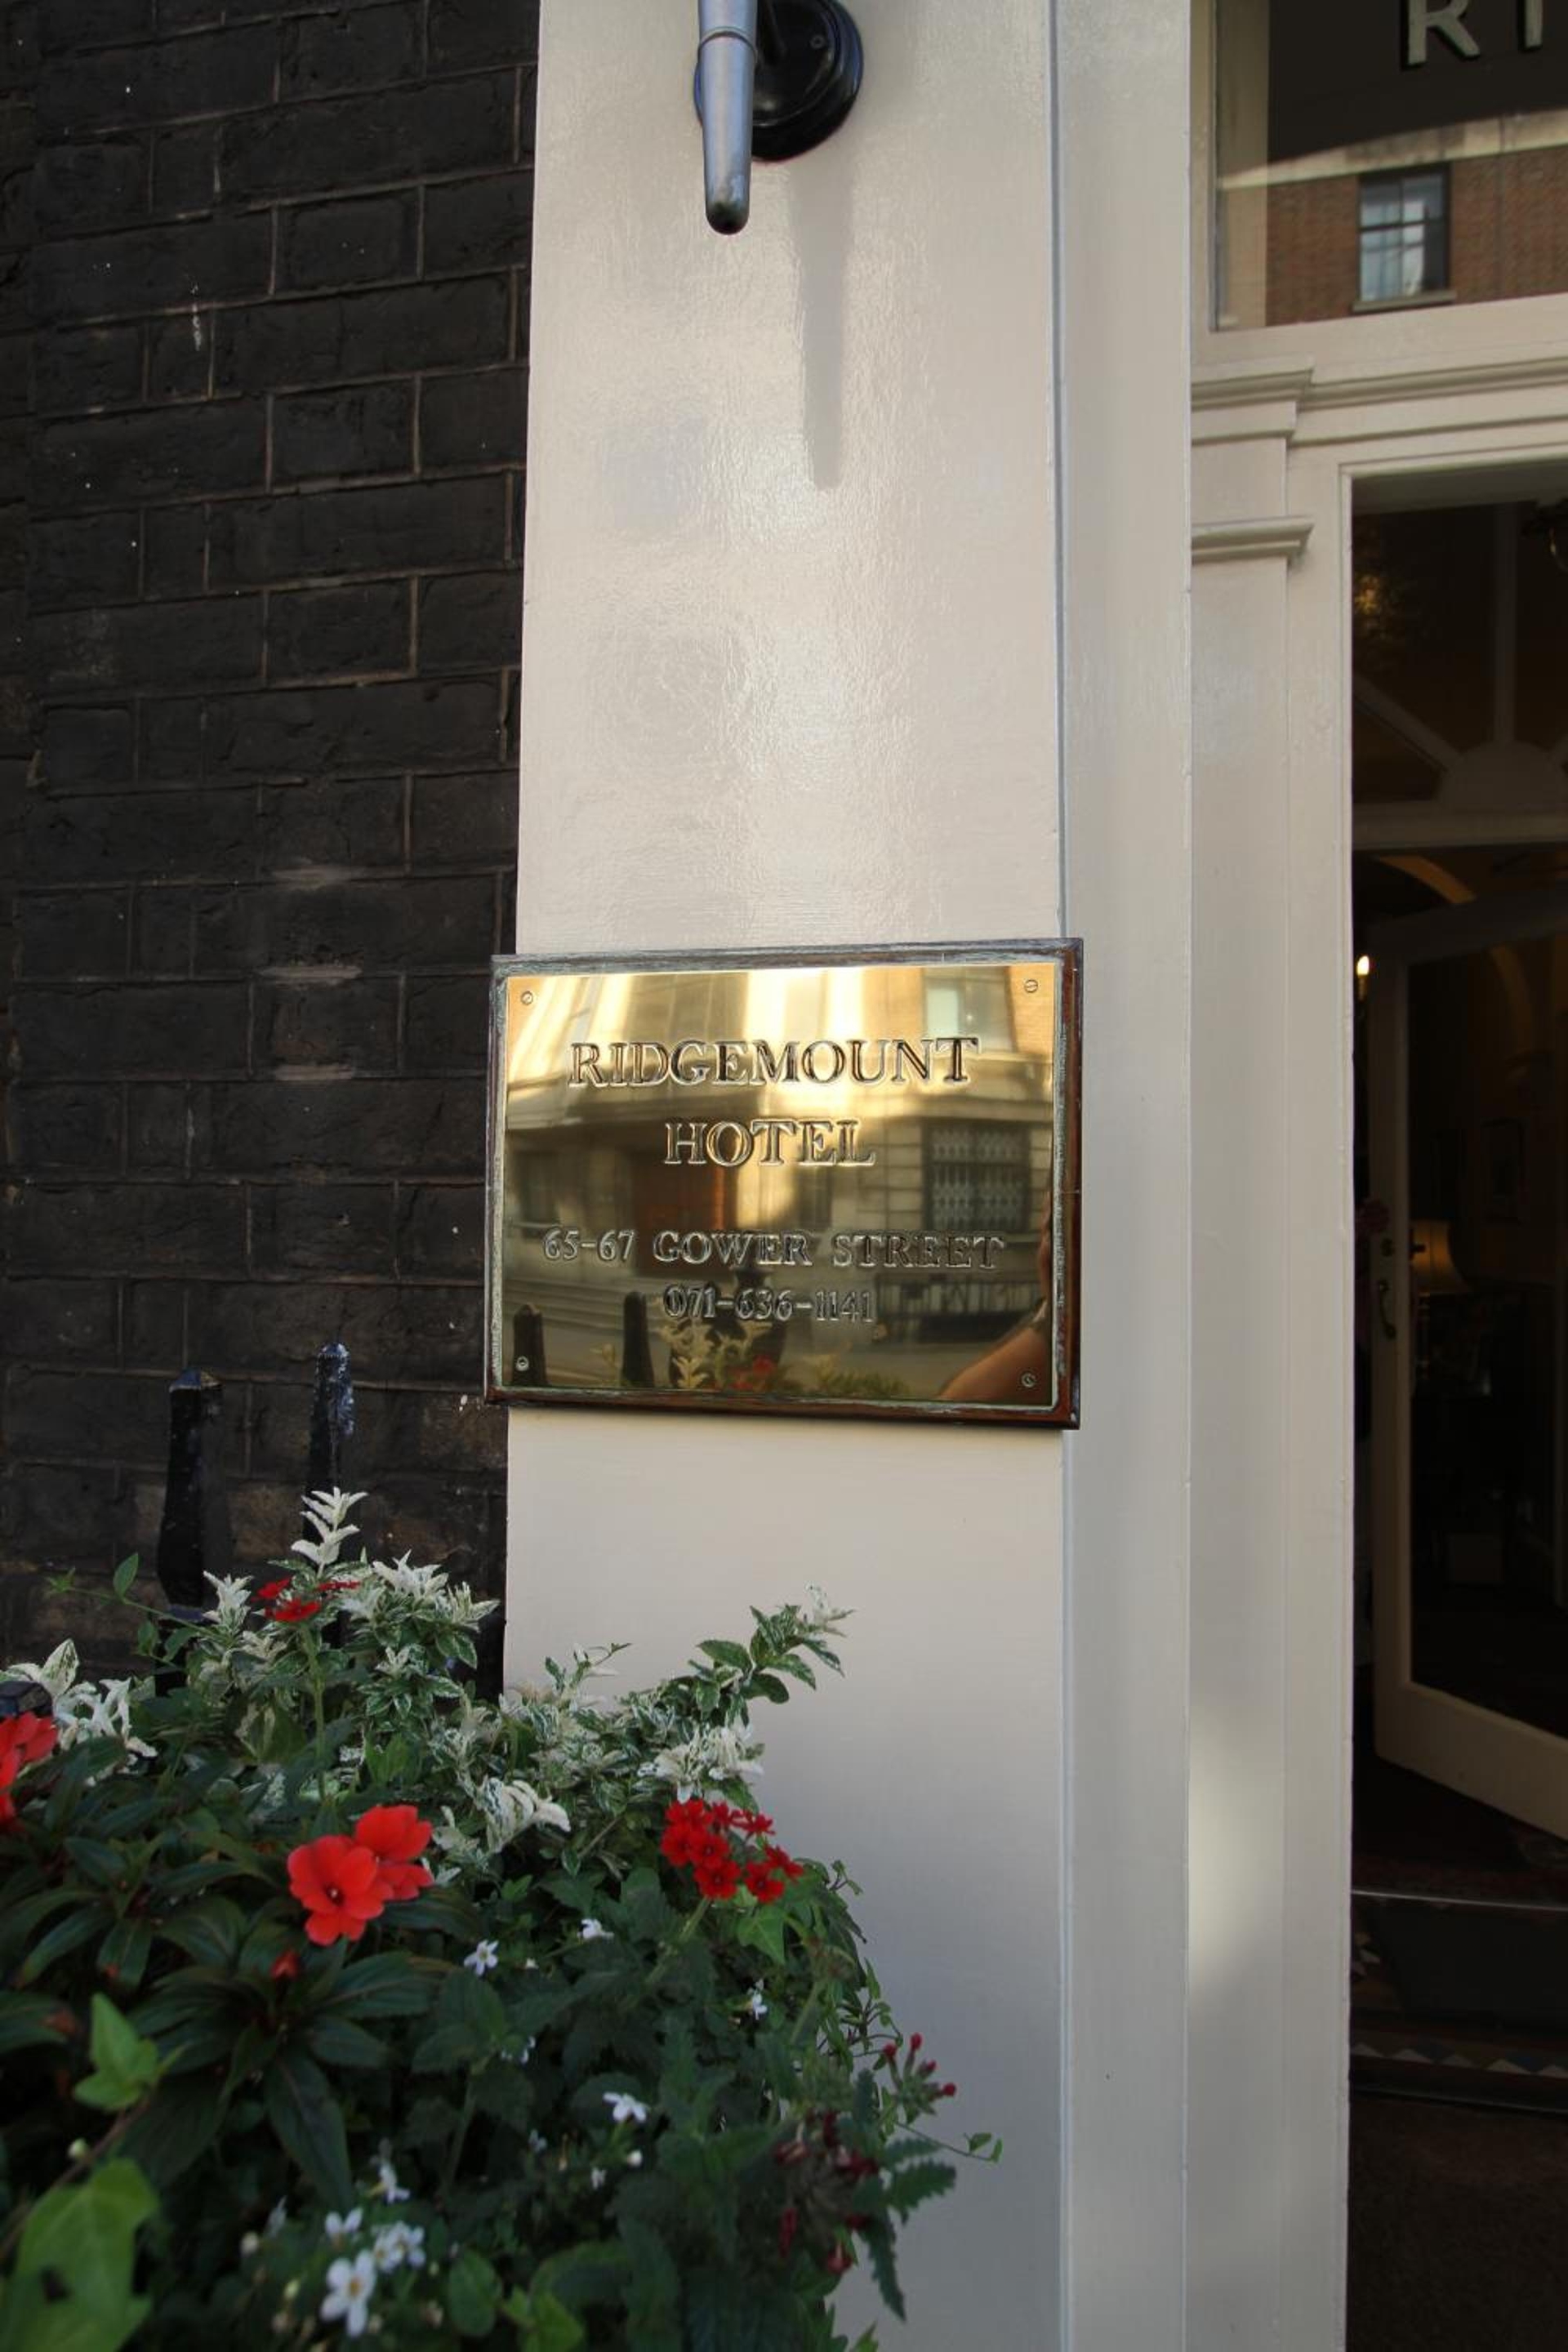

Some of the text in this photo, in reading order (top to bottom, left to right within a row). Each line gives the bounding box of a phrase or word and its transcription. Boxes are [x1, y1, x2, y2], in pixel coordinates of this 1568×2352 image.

[568, 1038, 979, 1088] RIDGEMOUNT
[663, 1118, 876, 1168] HOTEL
[543, 1227, 1005, 1269] 65-67 GOWER STREET
[662, 1282, 877, 1324] 071-636-1141
